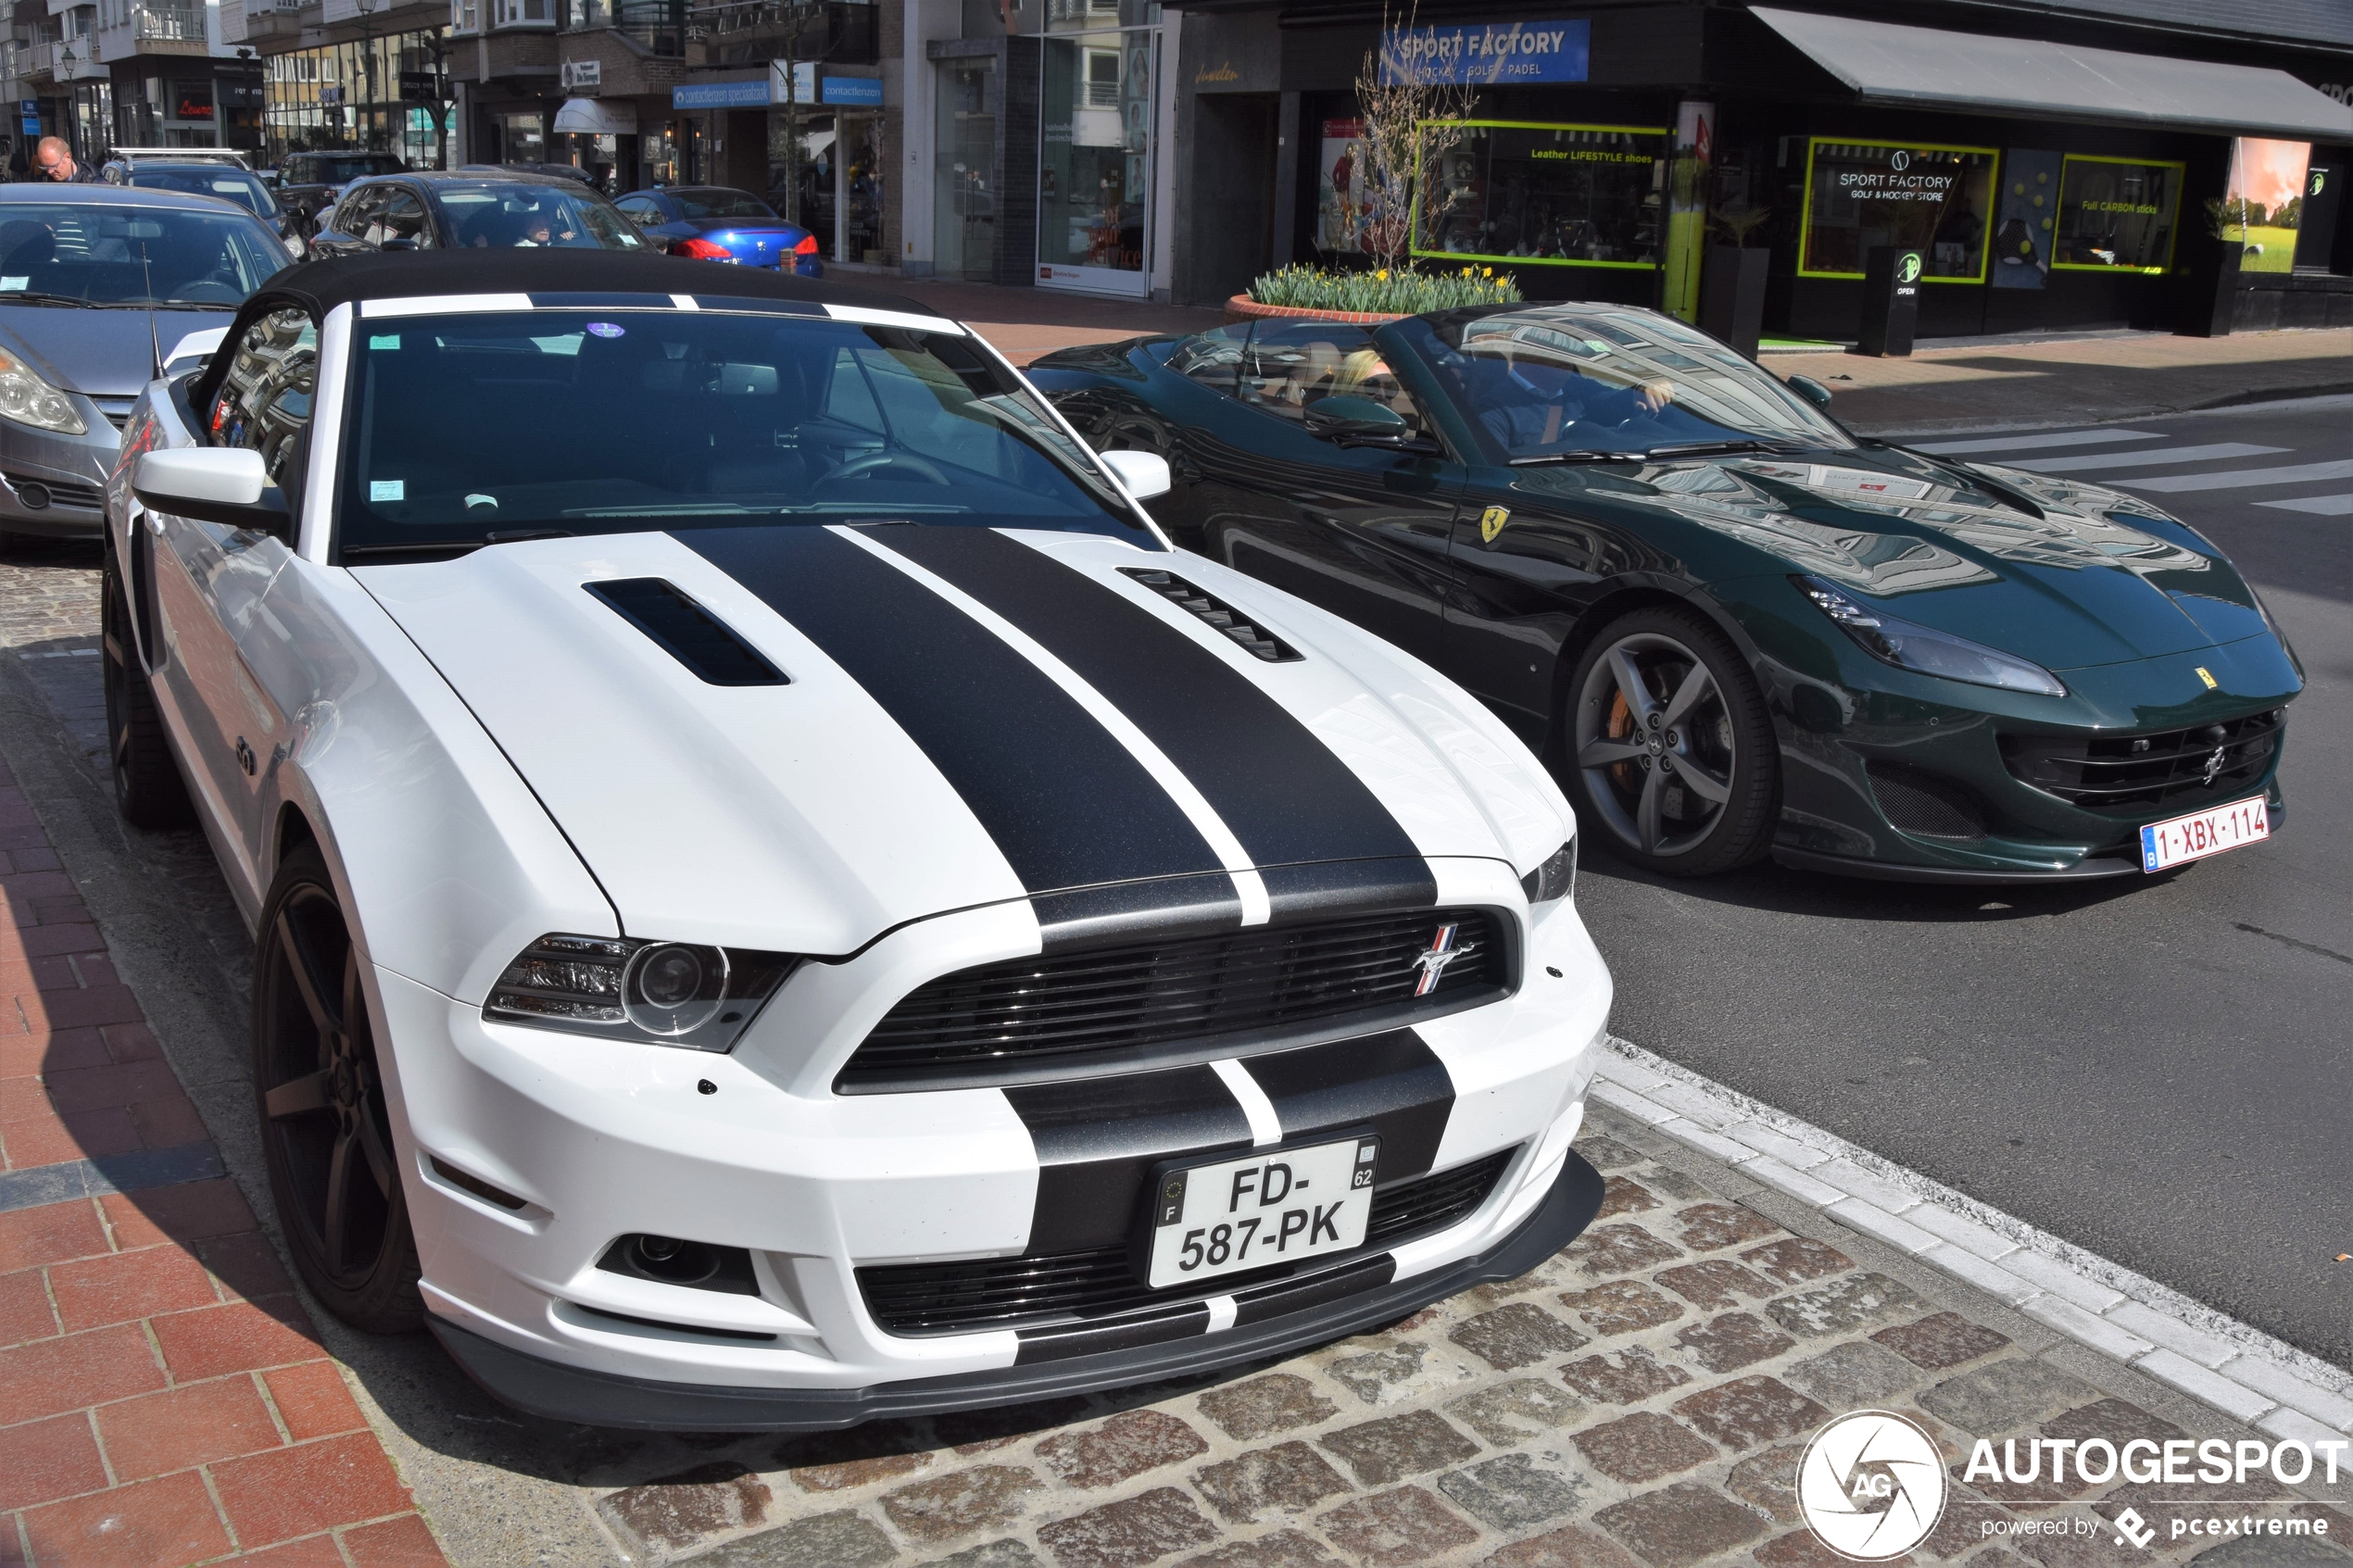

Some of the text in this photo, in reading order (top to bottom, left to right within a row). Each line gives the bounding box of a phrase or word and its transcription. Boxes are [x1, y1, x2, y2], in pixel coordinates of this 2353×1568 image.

[1401, 31, 1565, 59] SPORT FACTORY
[1418, 66, 1457, 77] HOCKEY
[1467, 64, 1493, 76] GOLF
[1508, 63, 1541, 75] PADEL
[686, 83, 768, 105] contactlenzen speciaalzaak
[825, 86, 880, 97] contactlenzen
[1531, 149, 1652, 163] Leather LIFESTYLE shoes
[1840, 173, 1952, 189] SPORT FACTORY
[1851, 190, 1943, 202] GOLF & HOCKEY STORE
[2082, 200, 2157, 214] Full CARBON sticks
[1086, 244, 1141, 267] service
[2146, 852, 2156, 867] B
[1354, 1169, 1373, 1187] 62
[1229, 1162, 1310, 1213] FD-
[1165, 1206, 1176, 1221] F
[1178, 1200, 1345, 1272] 587-PK
